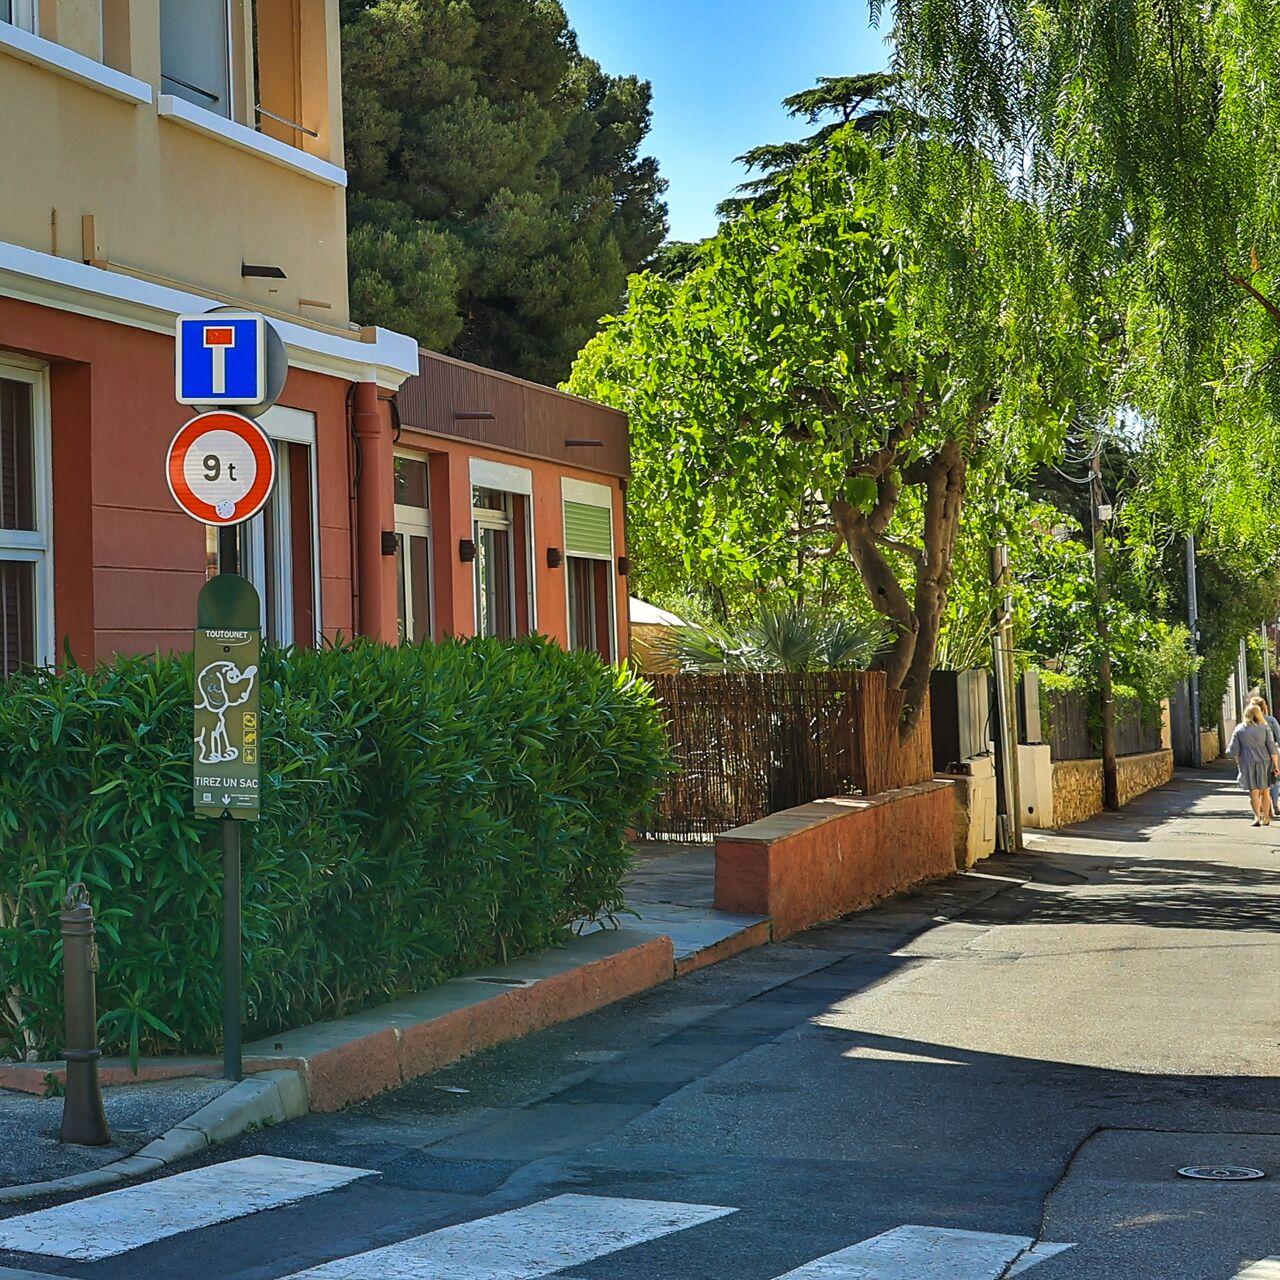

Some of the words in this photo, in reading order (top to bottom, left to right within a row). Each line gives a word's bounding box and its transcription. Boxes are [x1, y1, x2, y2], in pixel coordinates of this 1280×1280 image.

[202, 454, 221, 482] 9
[227, 462, 237, 482] t
[205, 630, 248, 639] TOUTOUNET
[194, 776, 221, 787] TIREZ
[223, 777, 238, 787] UN
[239, 778, 259, 788] SAC
